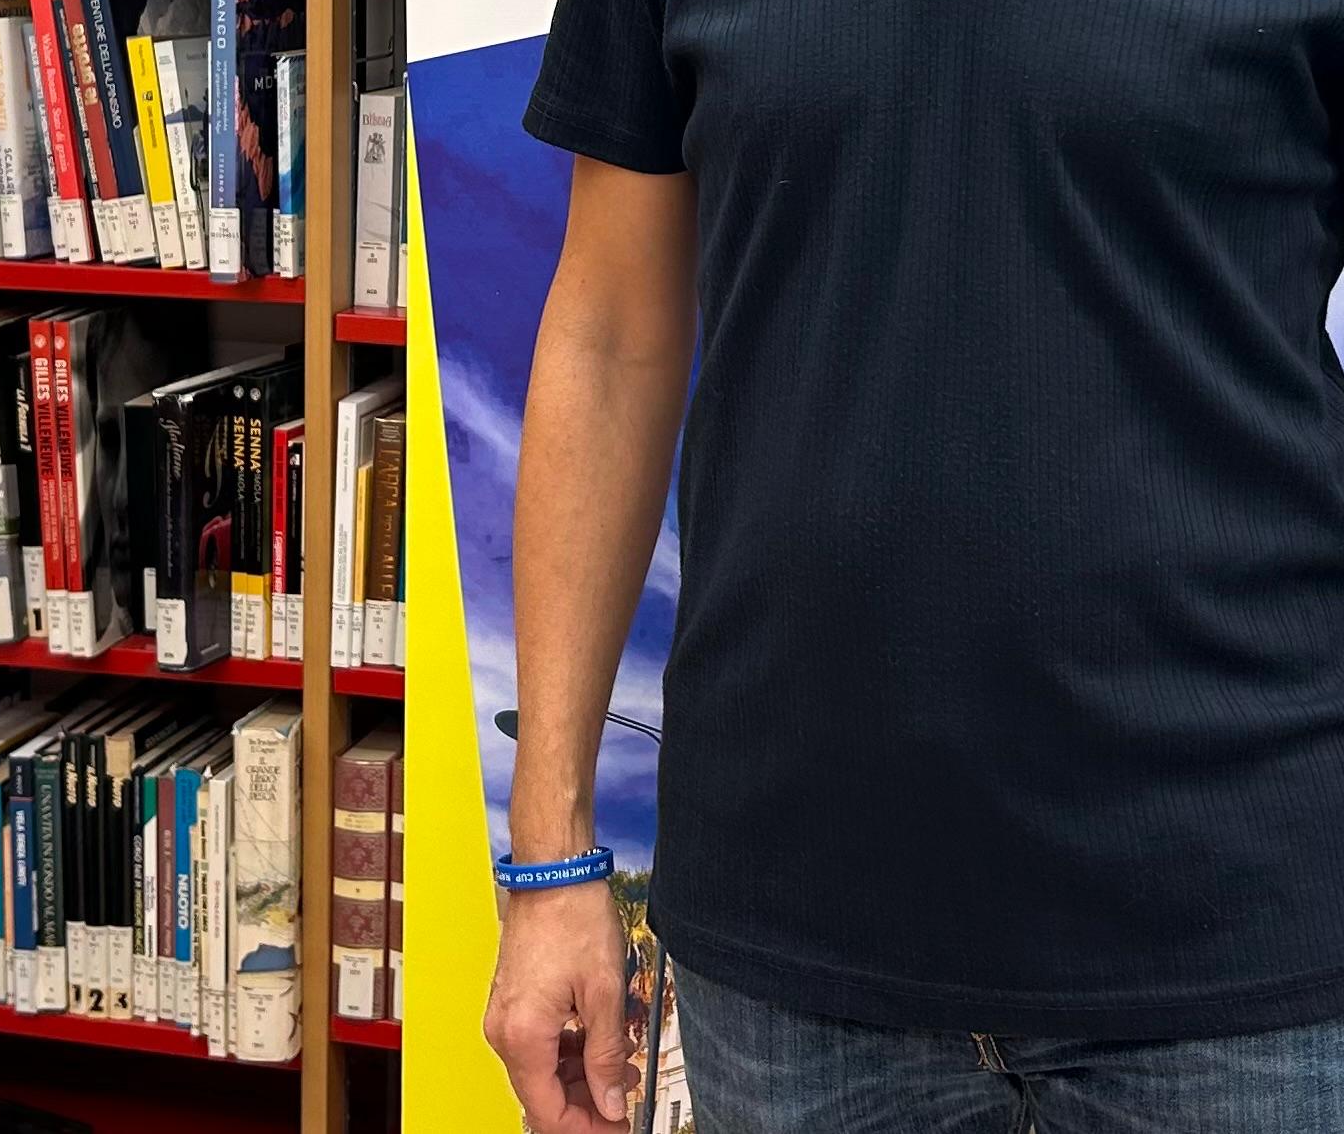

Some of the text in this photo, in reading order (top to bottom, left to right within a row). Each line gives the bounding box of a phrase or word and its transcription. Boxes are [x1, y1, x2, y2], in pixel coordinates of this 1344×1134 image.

[97, 45, 122, 129] DELL'ALPINISMO
[34, 358, 54, 475] GILLES VILLENEUVE
[54, 360, 72, 483] GILLES VILLENEUVE
[233, 416, 245, 470] SENNA
[250, 418, 261, 470] SENNA
[516, 874, 533, 882] CUP
[536, 864, 590, 882] AMERICA'S
[178, 874, 188, 930] NUOTO
